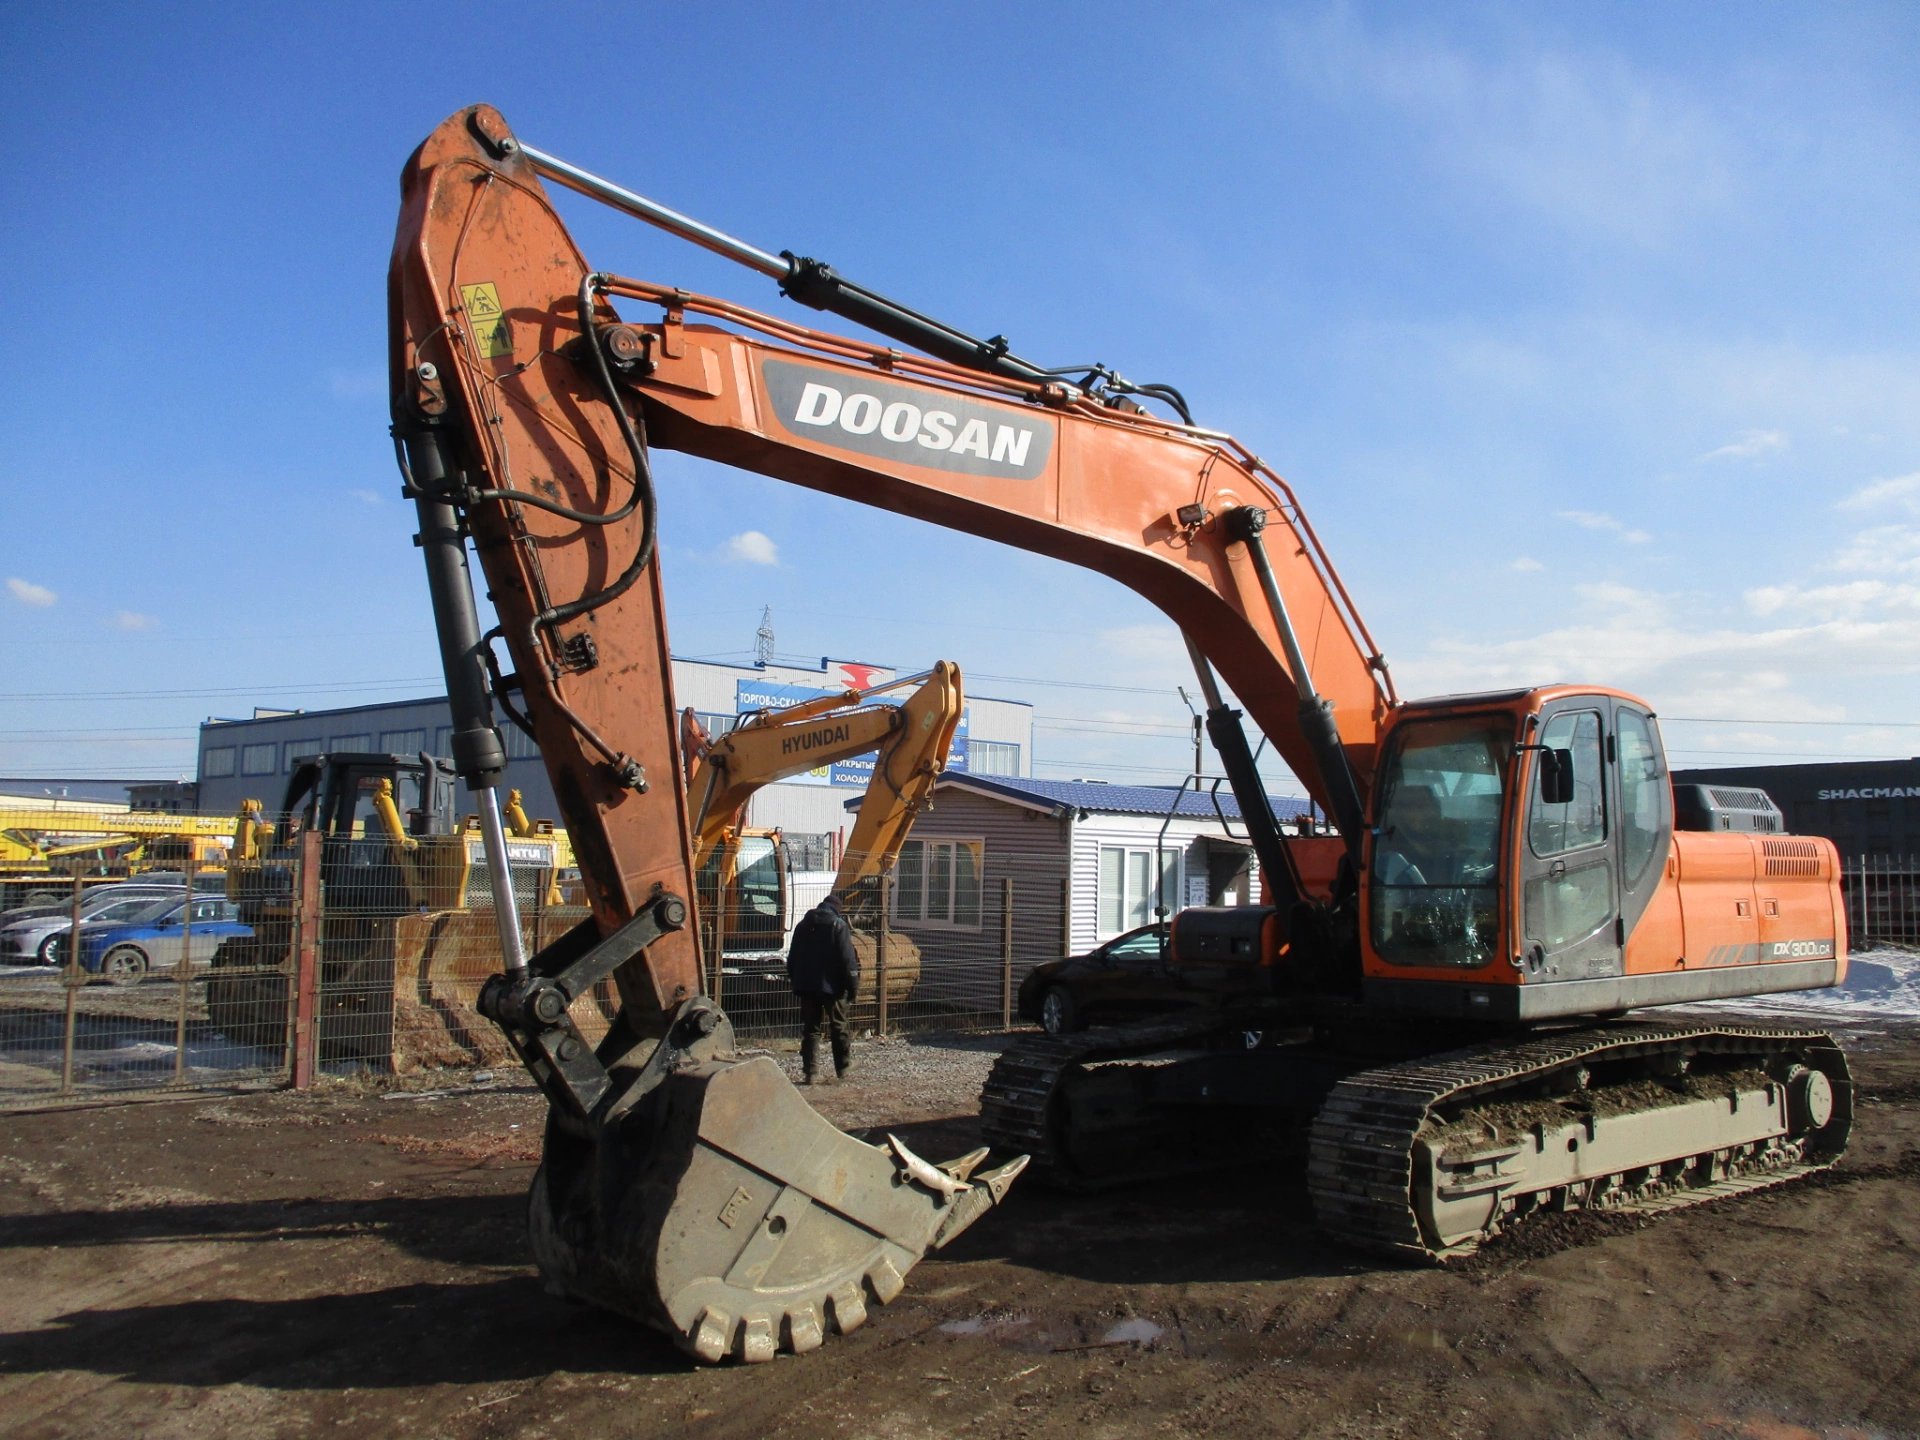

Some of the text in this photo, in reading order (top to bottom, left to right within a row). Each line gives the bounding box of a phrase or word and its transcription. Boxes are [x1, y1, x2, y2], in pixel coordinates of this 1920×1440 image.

[794, 382, 1033, 467] DOOSAN
[782, 724, 849, 754] HYUNDAI
[835, 773, 871, 785] ХОЛОДИ
[1817, 787, 1920, 800] SHACMAN
